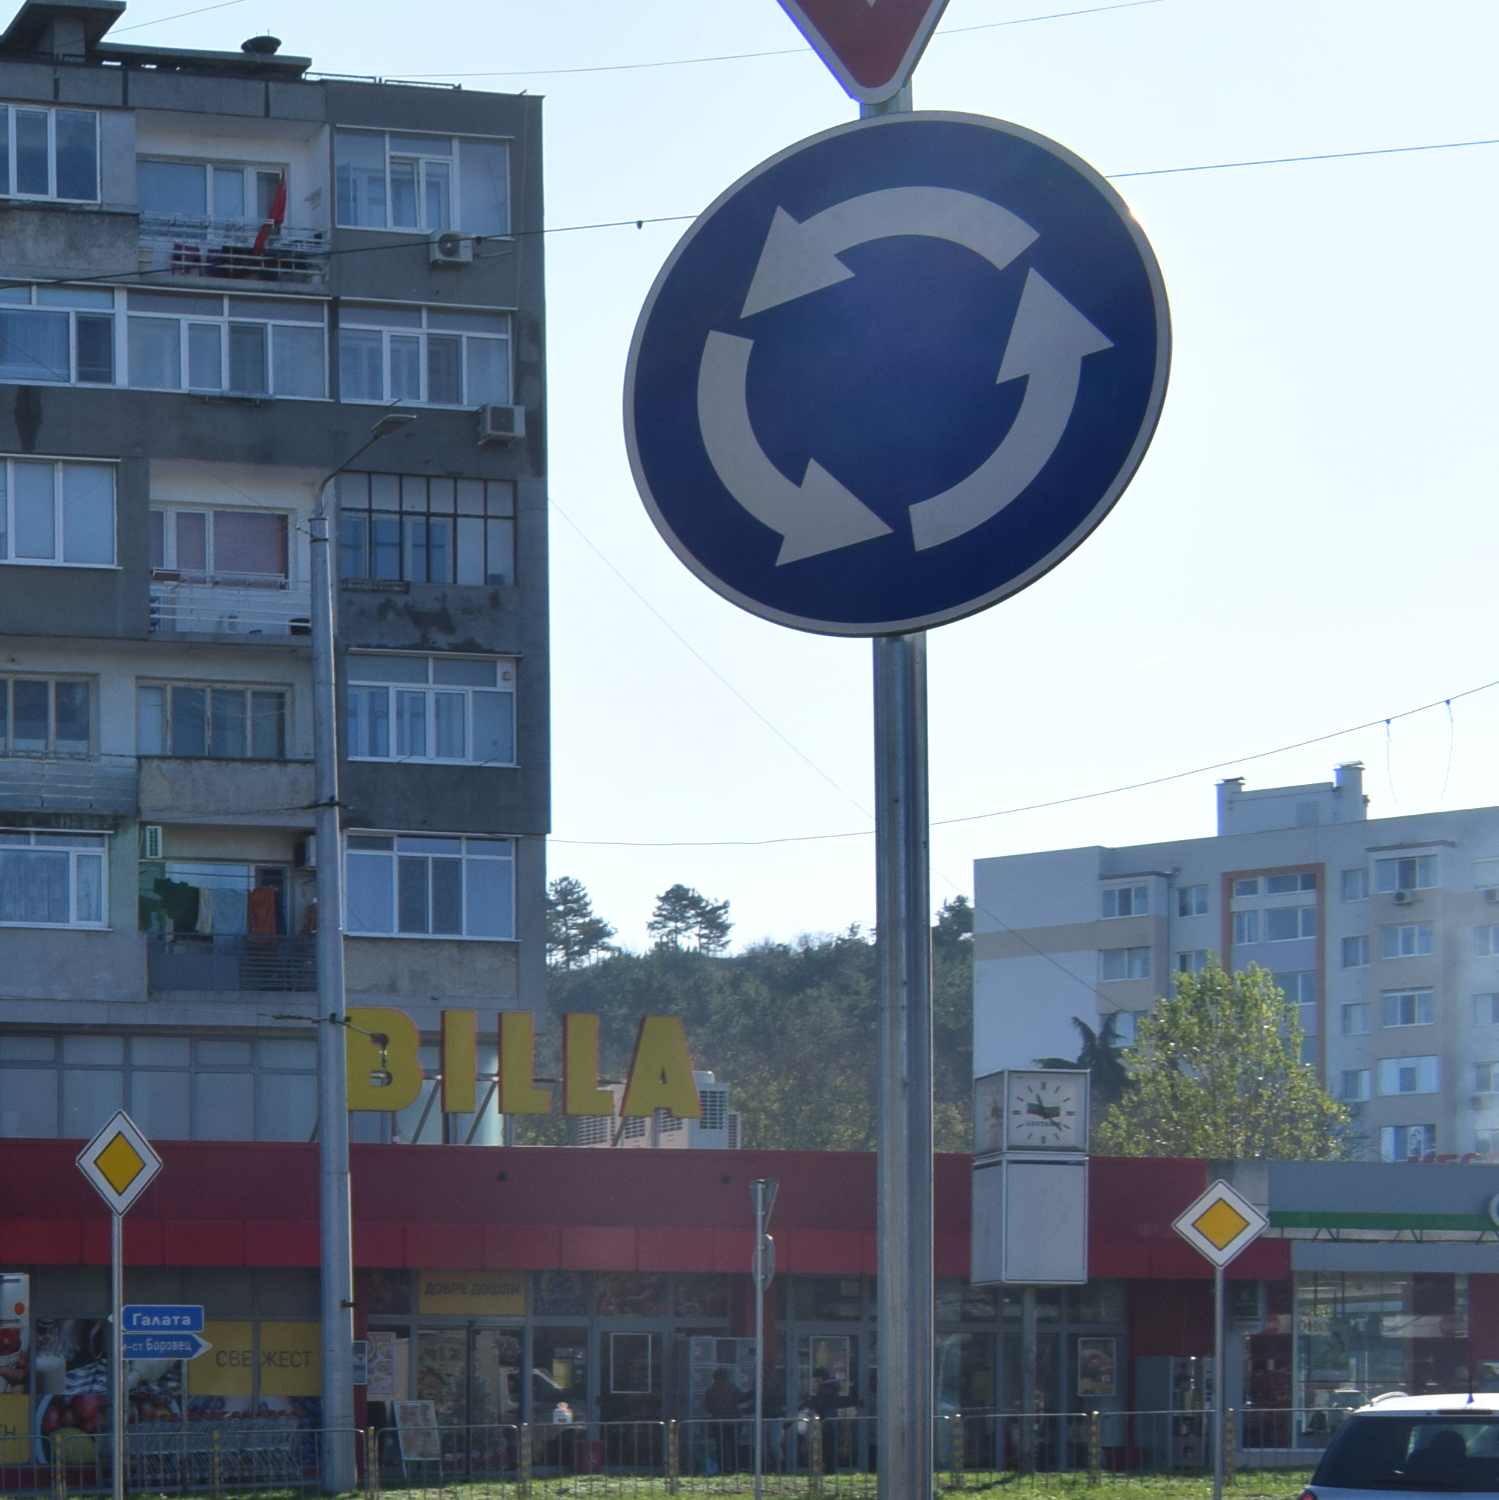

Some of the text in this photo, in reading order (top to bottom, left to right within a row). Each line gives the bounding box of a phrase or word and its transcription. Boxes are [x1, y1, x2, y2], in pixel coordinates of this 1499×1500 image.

[345, 1006, 704, 1118] BILLA
[425, 1282, 521, 1296] ДОБРЕ ДОШЛИ
[132, 1313, 192, 1327] Галата
[146, 1338, 193, 1354] Боровец
[216, 1350, 312, 1368] СВЕЖЕСТ
